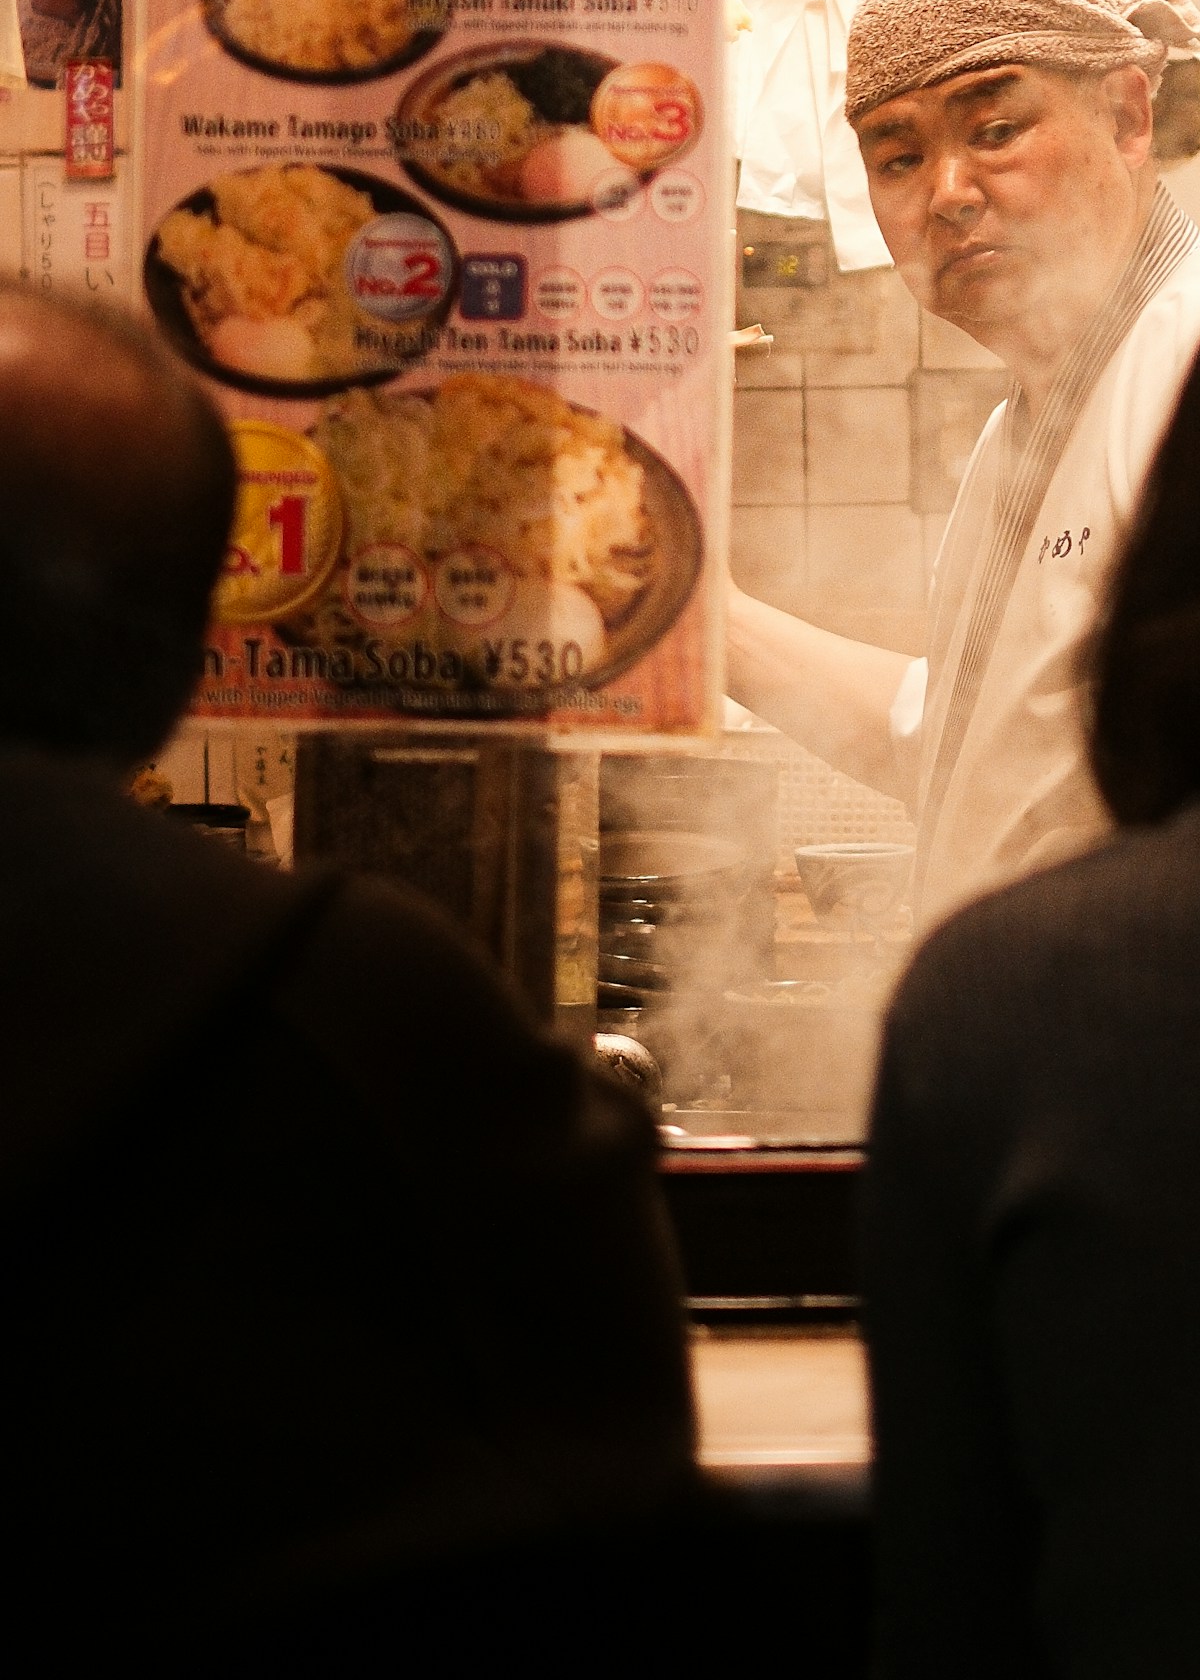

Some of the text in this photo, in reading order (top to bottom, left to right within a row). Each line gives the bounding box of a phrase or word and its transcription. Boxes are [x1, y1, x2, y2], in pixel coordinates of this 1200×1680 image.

[182, 114, 280, 138] Wakame
[288, 114, 378, 143] Tamago
[355, 251, 444, 298] No.2
[566, 327, 622, 352] Soba
[629, 325, 701, 354] ¥530
[365, 638, 463, 681] Soba
[483, 639, 583, 681] ¥530
